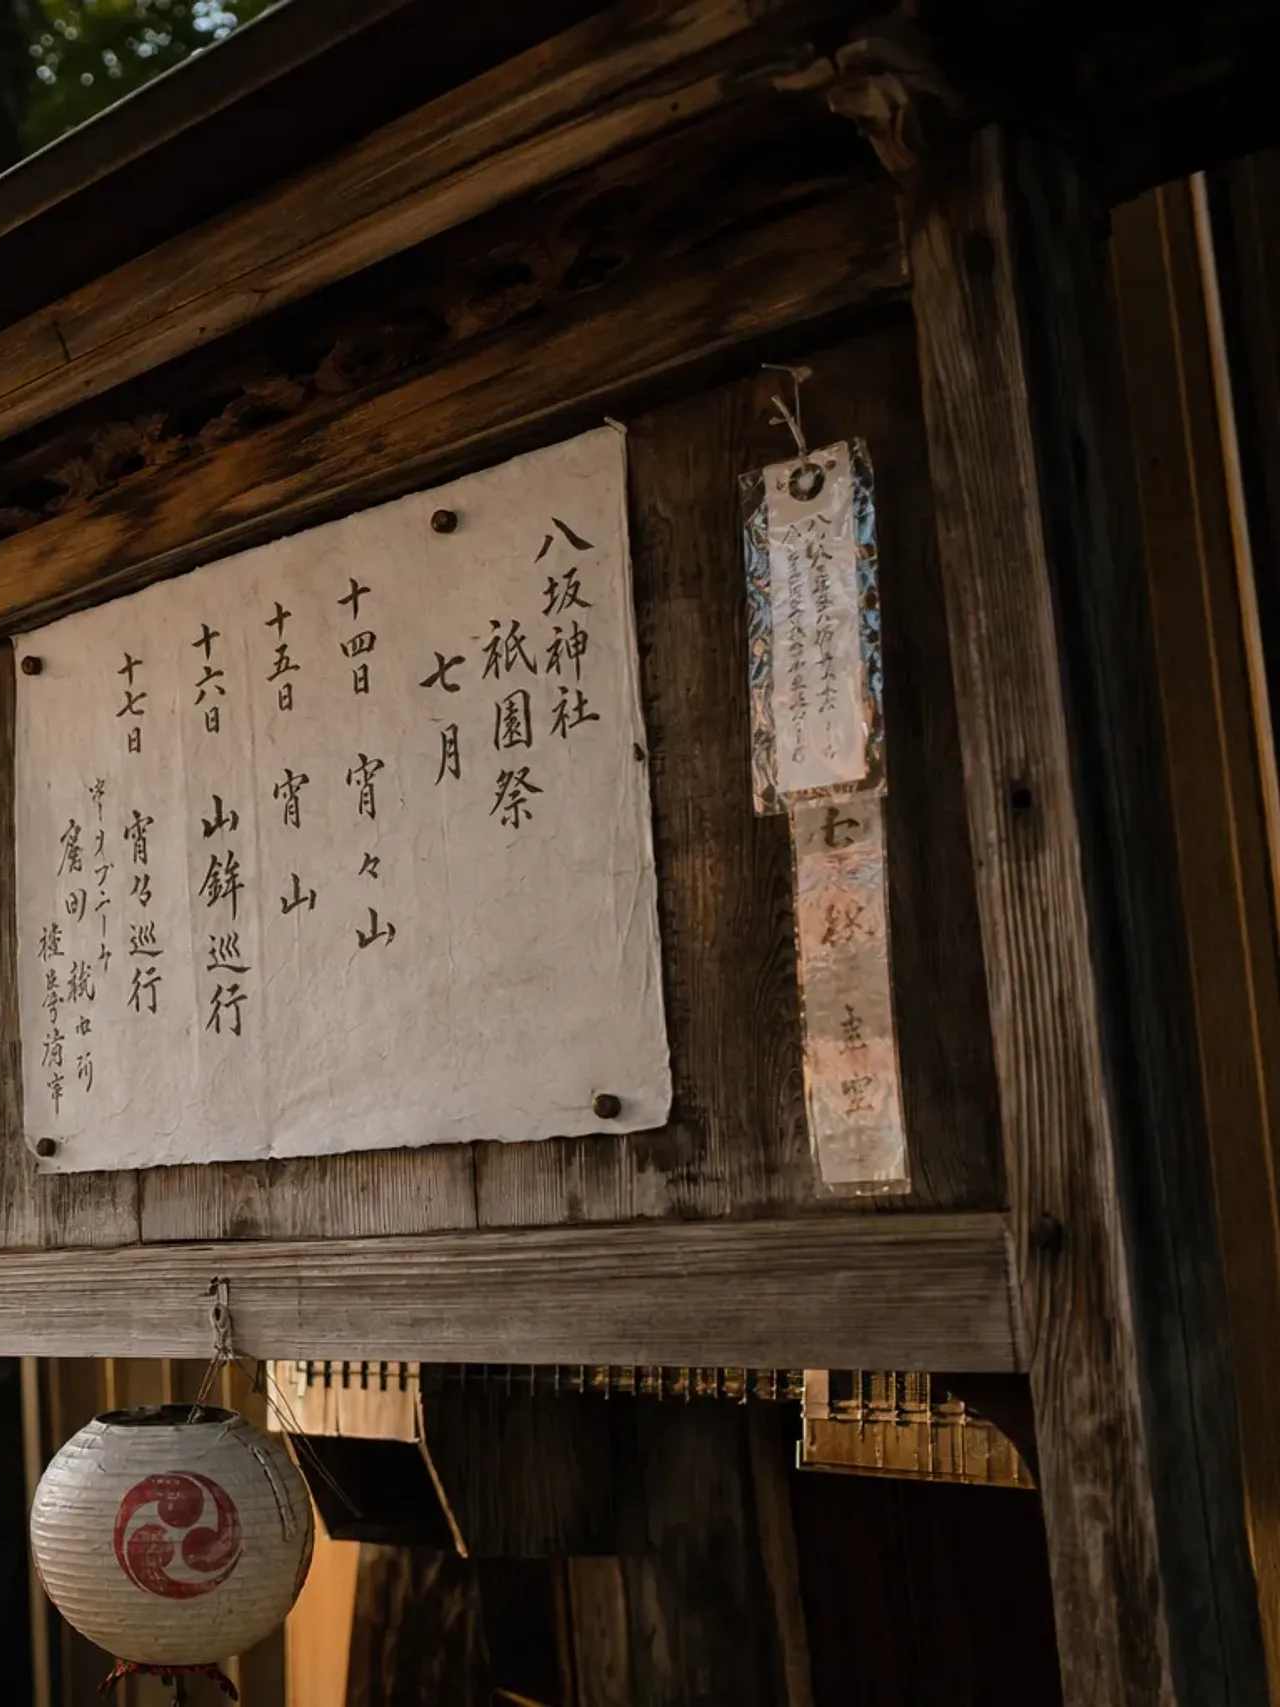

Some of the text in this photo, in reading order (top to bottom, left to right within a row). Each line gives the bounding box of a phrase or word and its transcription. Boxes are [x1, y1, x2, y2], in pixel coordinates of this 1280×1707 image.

[264, 601, 302, 713] 十五日
[336, 577, 378, 696] 十四日
[533, 515, 601, 741] 八坂神社
[114, 652, 150, 755] 十七日
[417, 651, 468, 786] 七月
[191, 623, 252, 1038] 十六日 山鉾巡行
